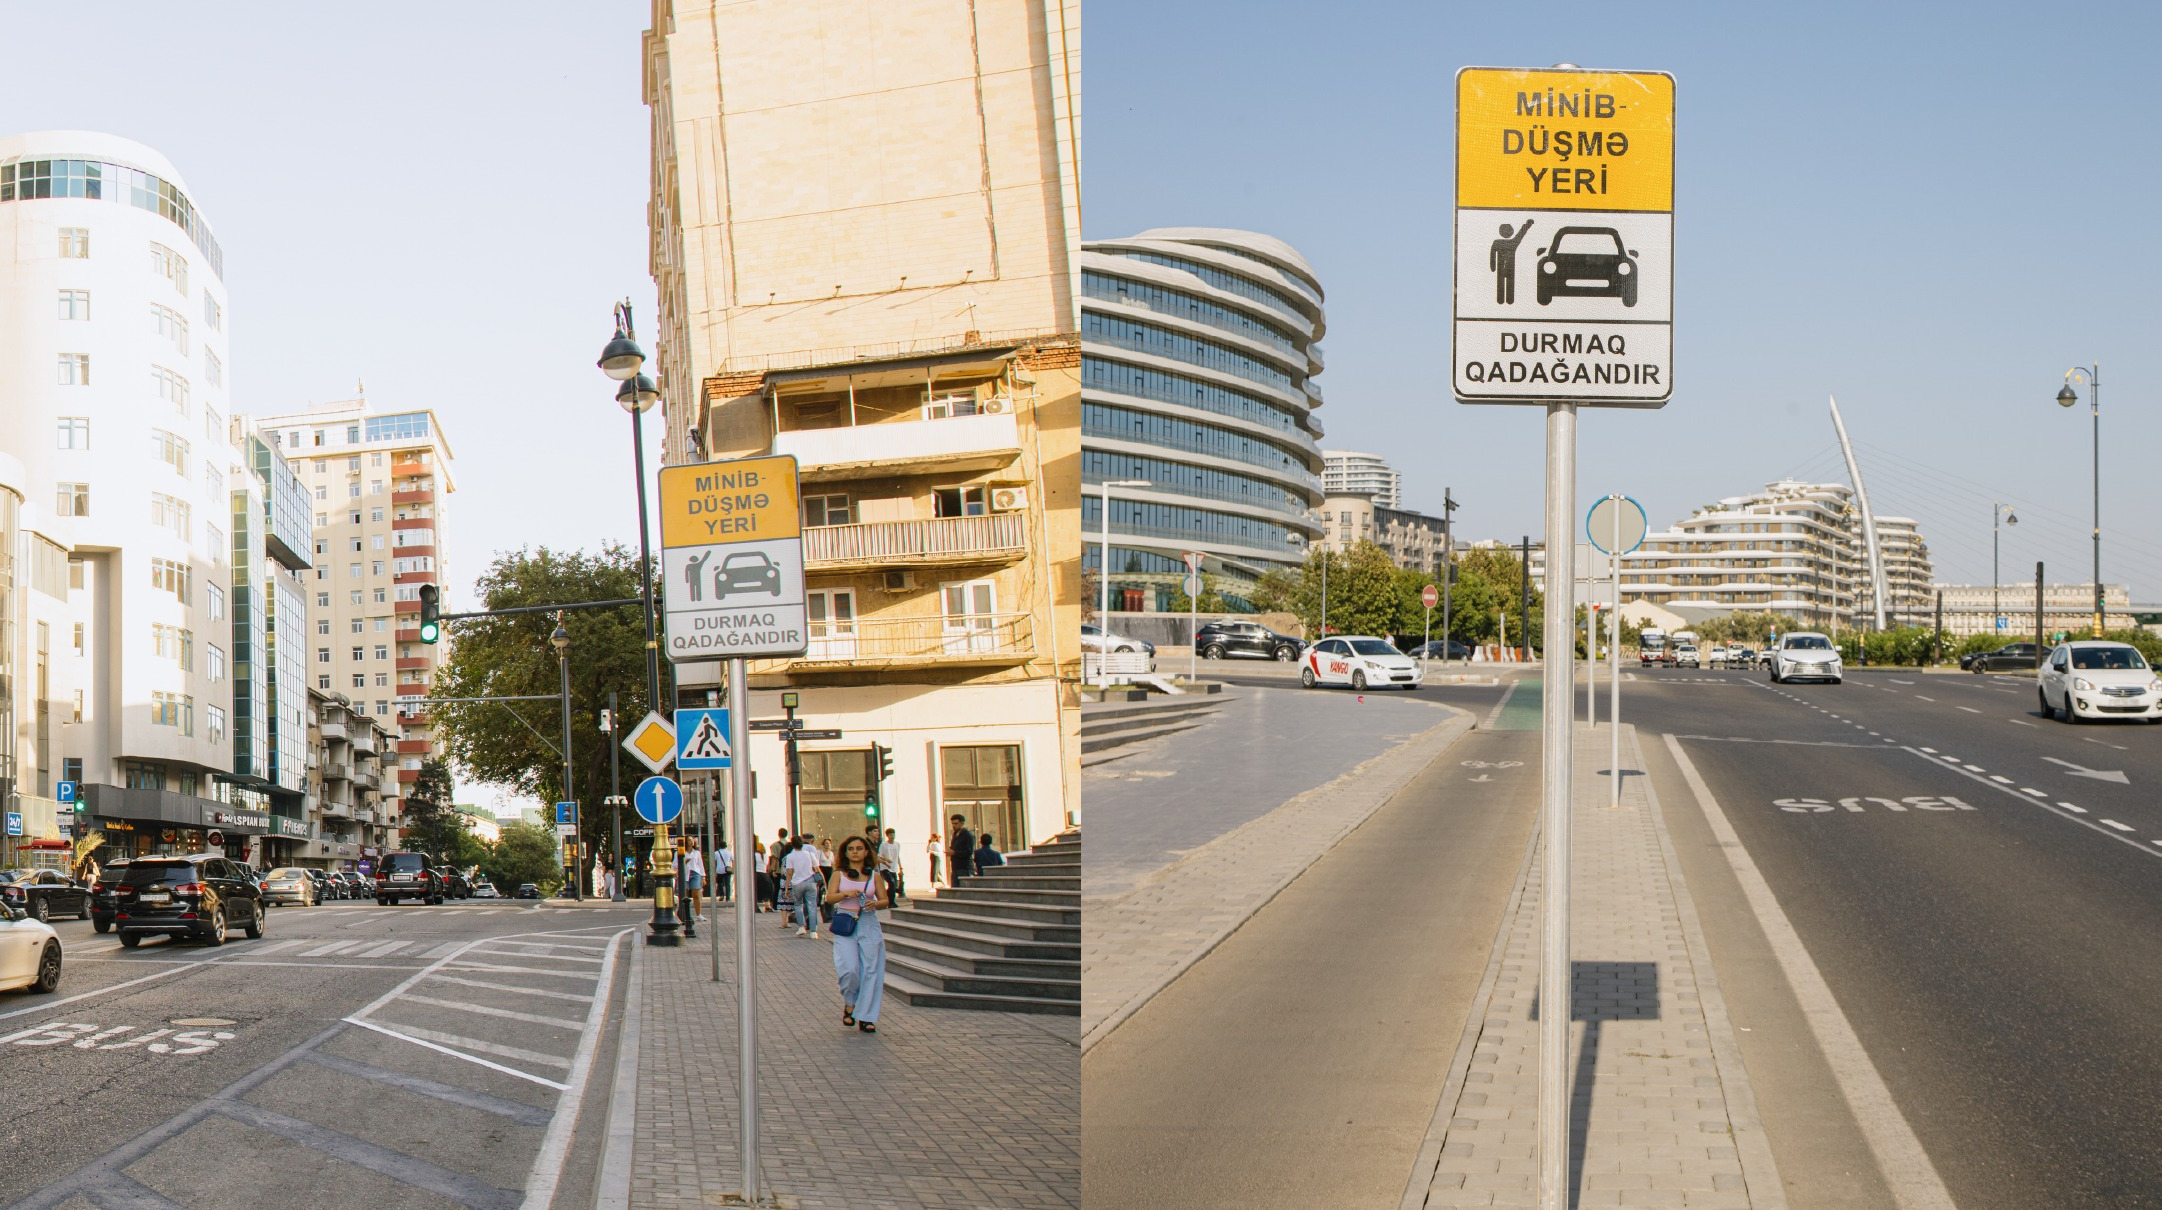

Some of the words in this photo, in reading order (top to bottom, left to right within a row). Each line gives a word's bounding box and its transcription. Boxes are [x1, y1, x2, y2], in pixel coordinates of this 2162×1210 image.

[1516, 87, 1627, 119] MİNİB-
[1502, 124, 1629, 162] DÜŞMƏ
[1526, 163, 1607, 194] YERİ
[1501, 332, 1626, 356] DURMAQ
[1465, 358, 1661, 385] QADAĞANDIR
[695, 470, 767, 493] MİNİB-
[688, 493, 770, 515] DÜŞMƏ
[704, 513, 757, 535] YERİ
[694, 613, 776, 630] DURMAQ
[673, 629, 800, 649] QADAĞANDIR
[1330, 661, 1349, 674] YANGO
[61, 783, 72, 800] P
[1772, 796, 1978, 813] BUS
[9, 816, 21, 828] 24/7
[233, 815, 258, 827] ASPIAN
[283, 820, 308, 836] FRIENDS
[0, 1022, 236, 1054] BUS
